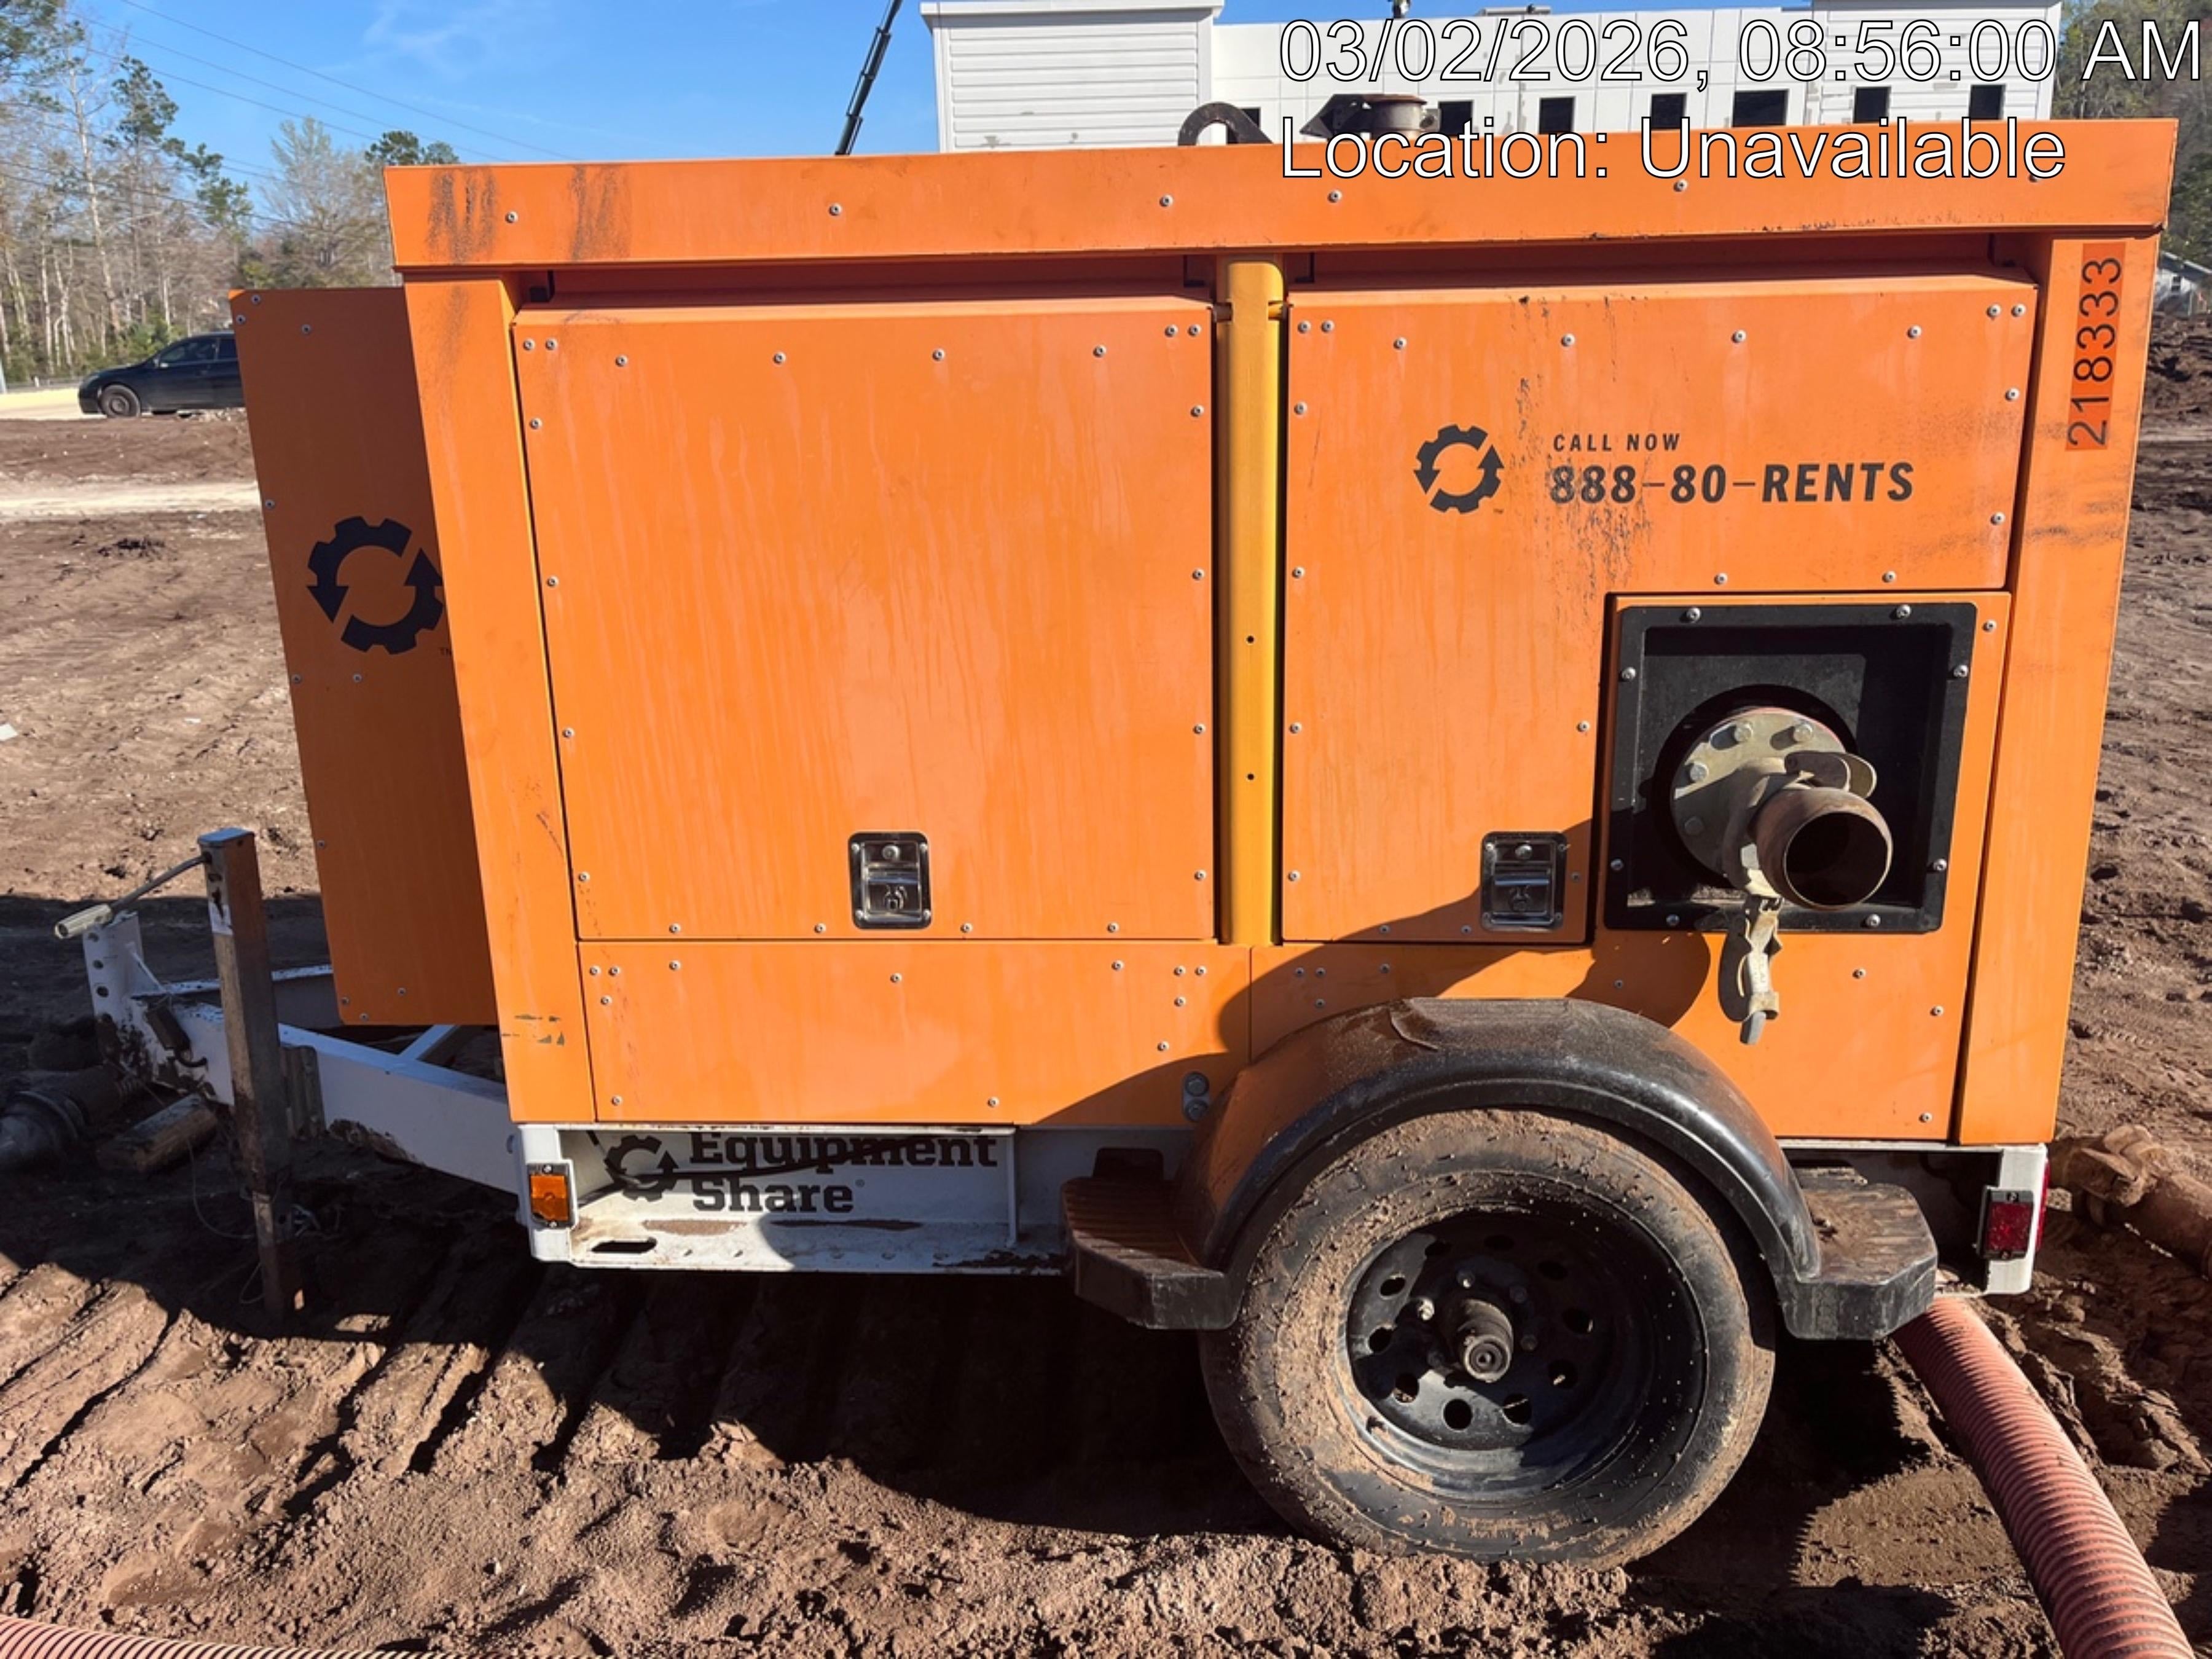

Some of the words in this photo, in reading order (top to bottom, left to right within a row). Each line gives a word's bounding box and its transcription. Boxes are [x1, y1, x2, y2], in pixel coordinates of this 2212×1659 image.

[2067, 257, 2122, 446] 218333
[1553, 434, 1613, 452] CALL
[1626, 433, 1681, 450] NOW
[1550, 462, 1914, 504] 888-80-RENTS
[689, 1132, 998, 1174] Equipment
[692, 1176, 854, 1213] Share
